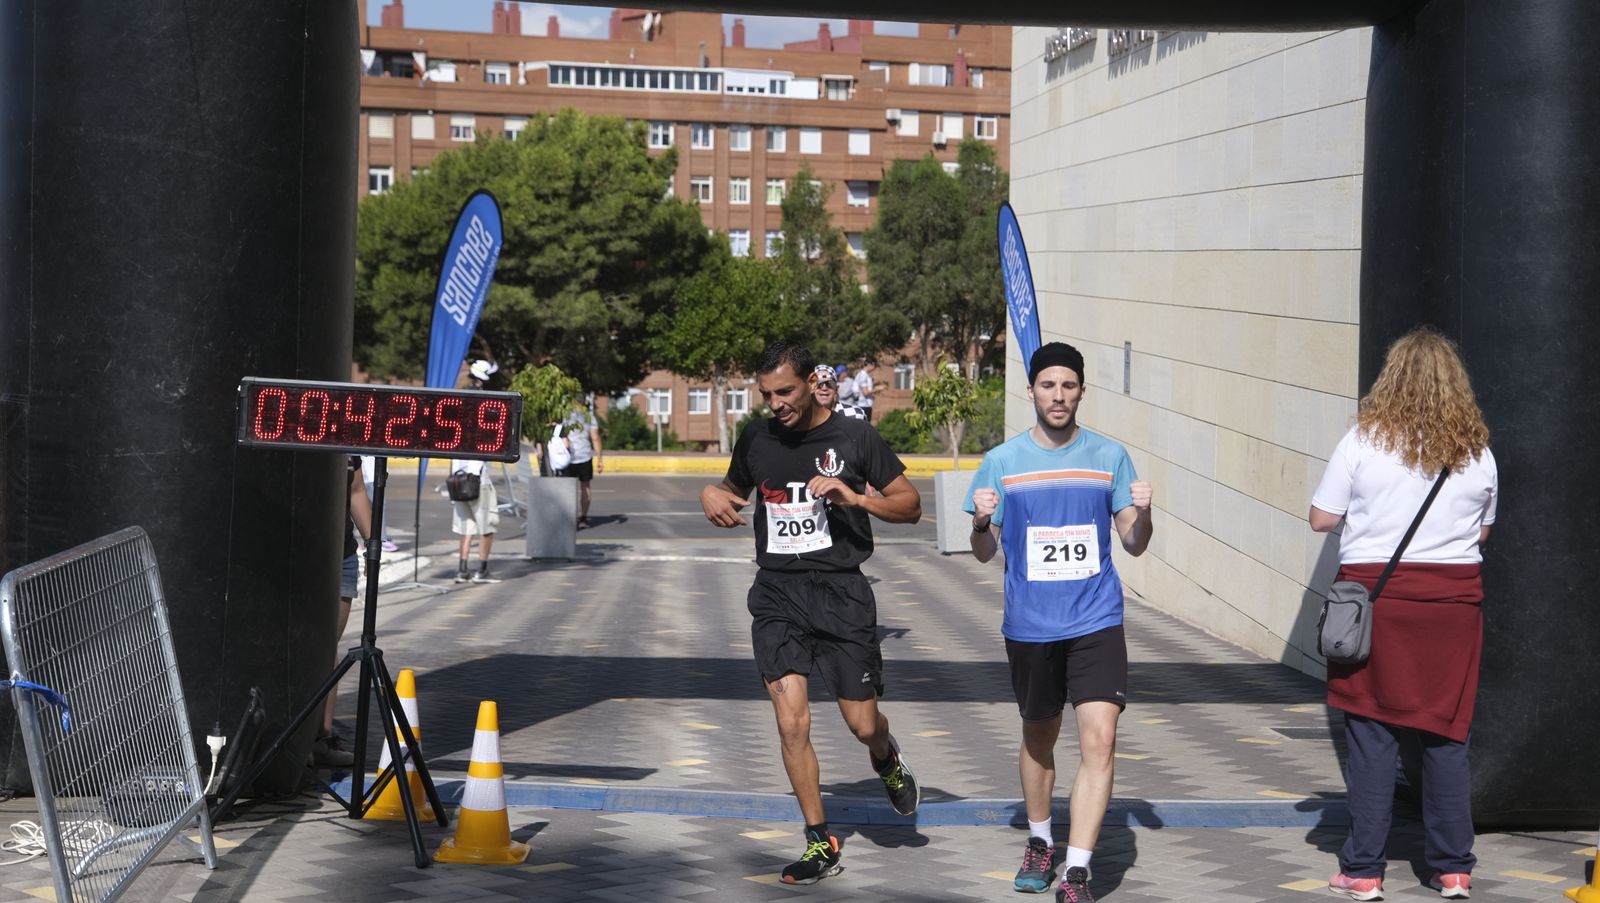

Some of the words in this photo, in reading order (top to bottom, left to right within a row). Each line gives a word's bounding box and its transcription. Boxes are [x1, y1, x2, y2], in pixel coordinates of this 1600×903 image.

[254, 387, 506, 452] 00:42:59
[777, 518, 816, 537] 209
[1043, 544, 1087, 562] 219
